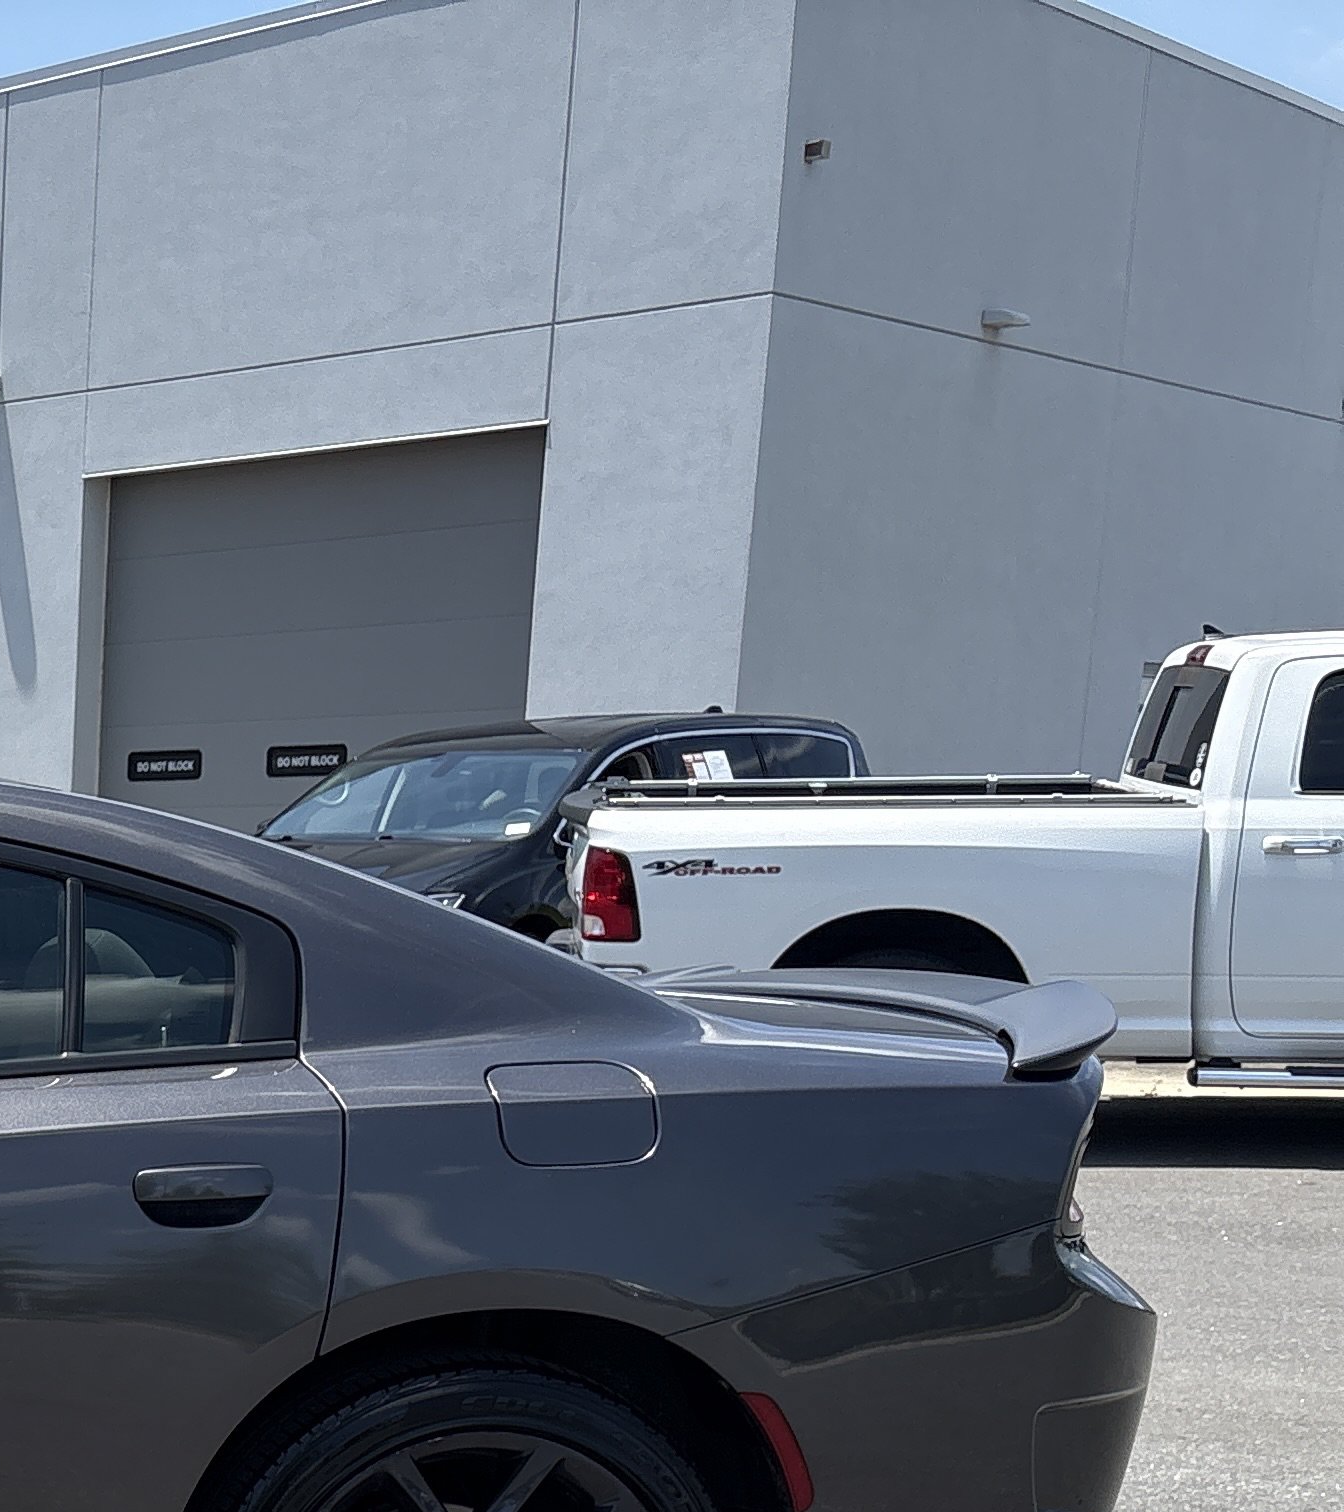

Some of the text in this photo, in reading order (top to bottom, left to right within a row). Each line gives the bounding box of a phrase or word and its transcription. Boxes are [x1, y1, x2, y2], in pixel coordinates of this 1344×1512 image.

[137, 760, 194, 772] DO NOT BLOCK
[277, 754, 339, 768] DO NOT BLOCK
[674, 866, 782, 876] OFF-ROAD
